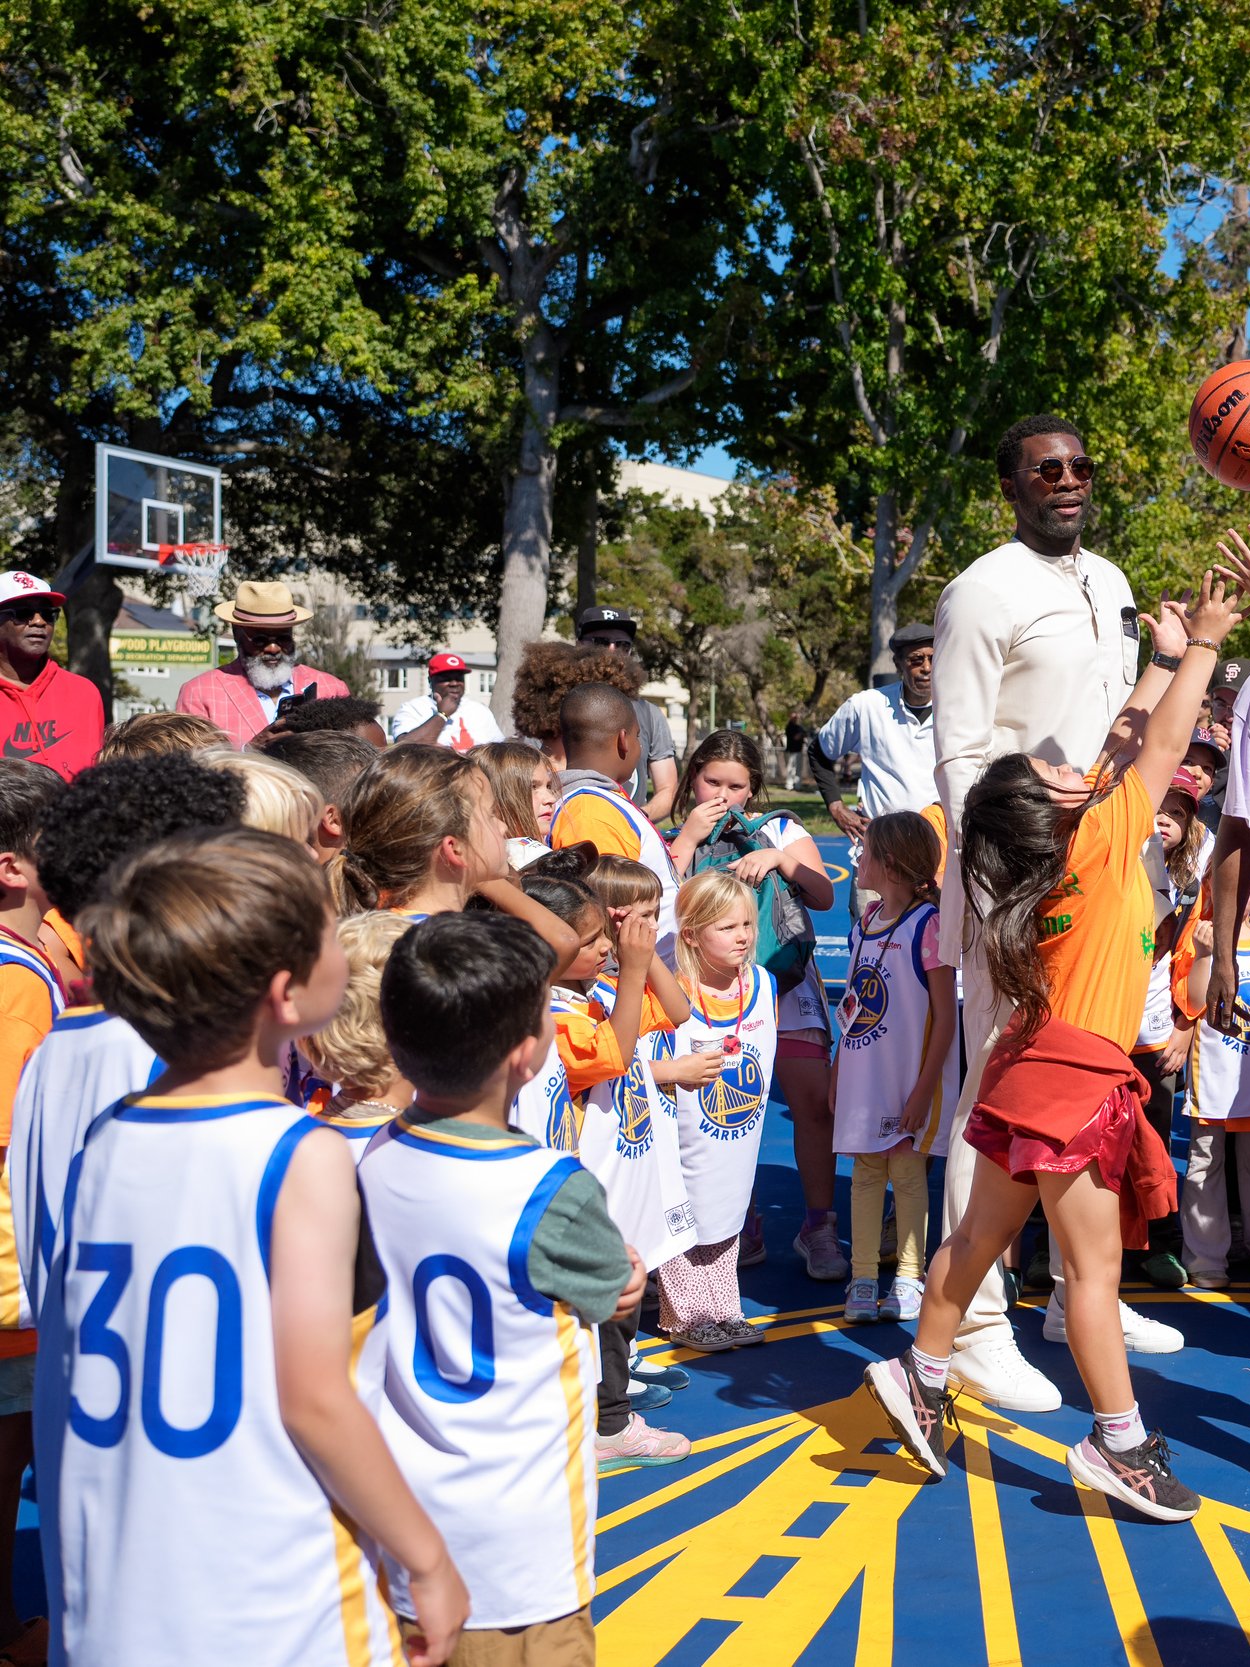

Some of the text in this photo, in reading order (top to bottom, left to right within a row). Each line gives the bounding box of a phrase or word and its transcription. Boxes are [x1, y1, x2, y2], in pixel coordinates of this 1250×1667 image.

[1196, 389, 1247, 463] Wilson
[148, 638, 210, 653] PLAYGROUND
[13, 719, 57, 743] NKE
[741, 1018, 765, 1032] Rakuten
[842, 1023, 888, 1051] RRIORS
[721, 1060, 742, 1069] oney
[737, 1062, 757, 1088] 10
[698, 1102, 766, 1141] WARRIORS
[412, 1254, 496, 1404] 0
[68, 1241, 243, 1459] 30
